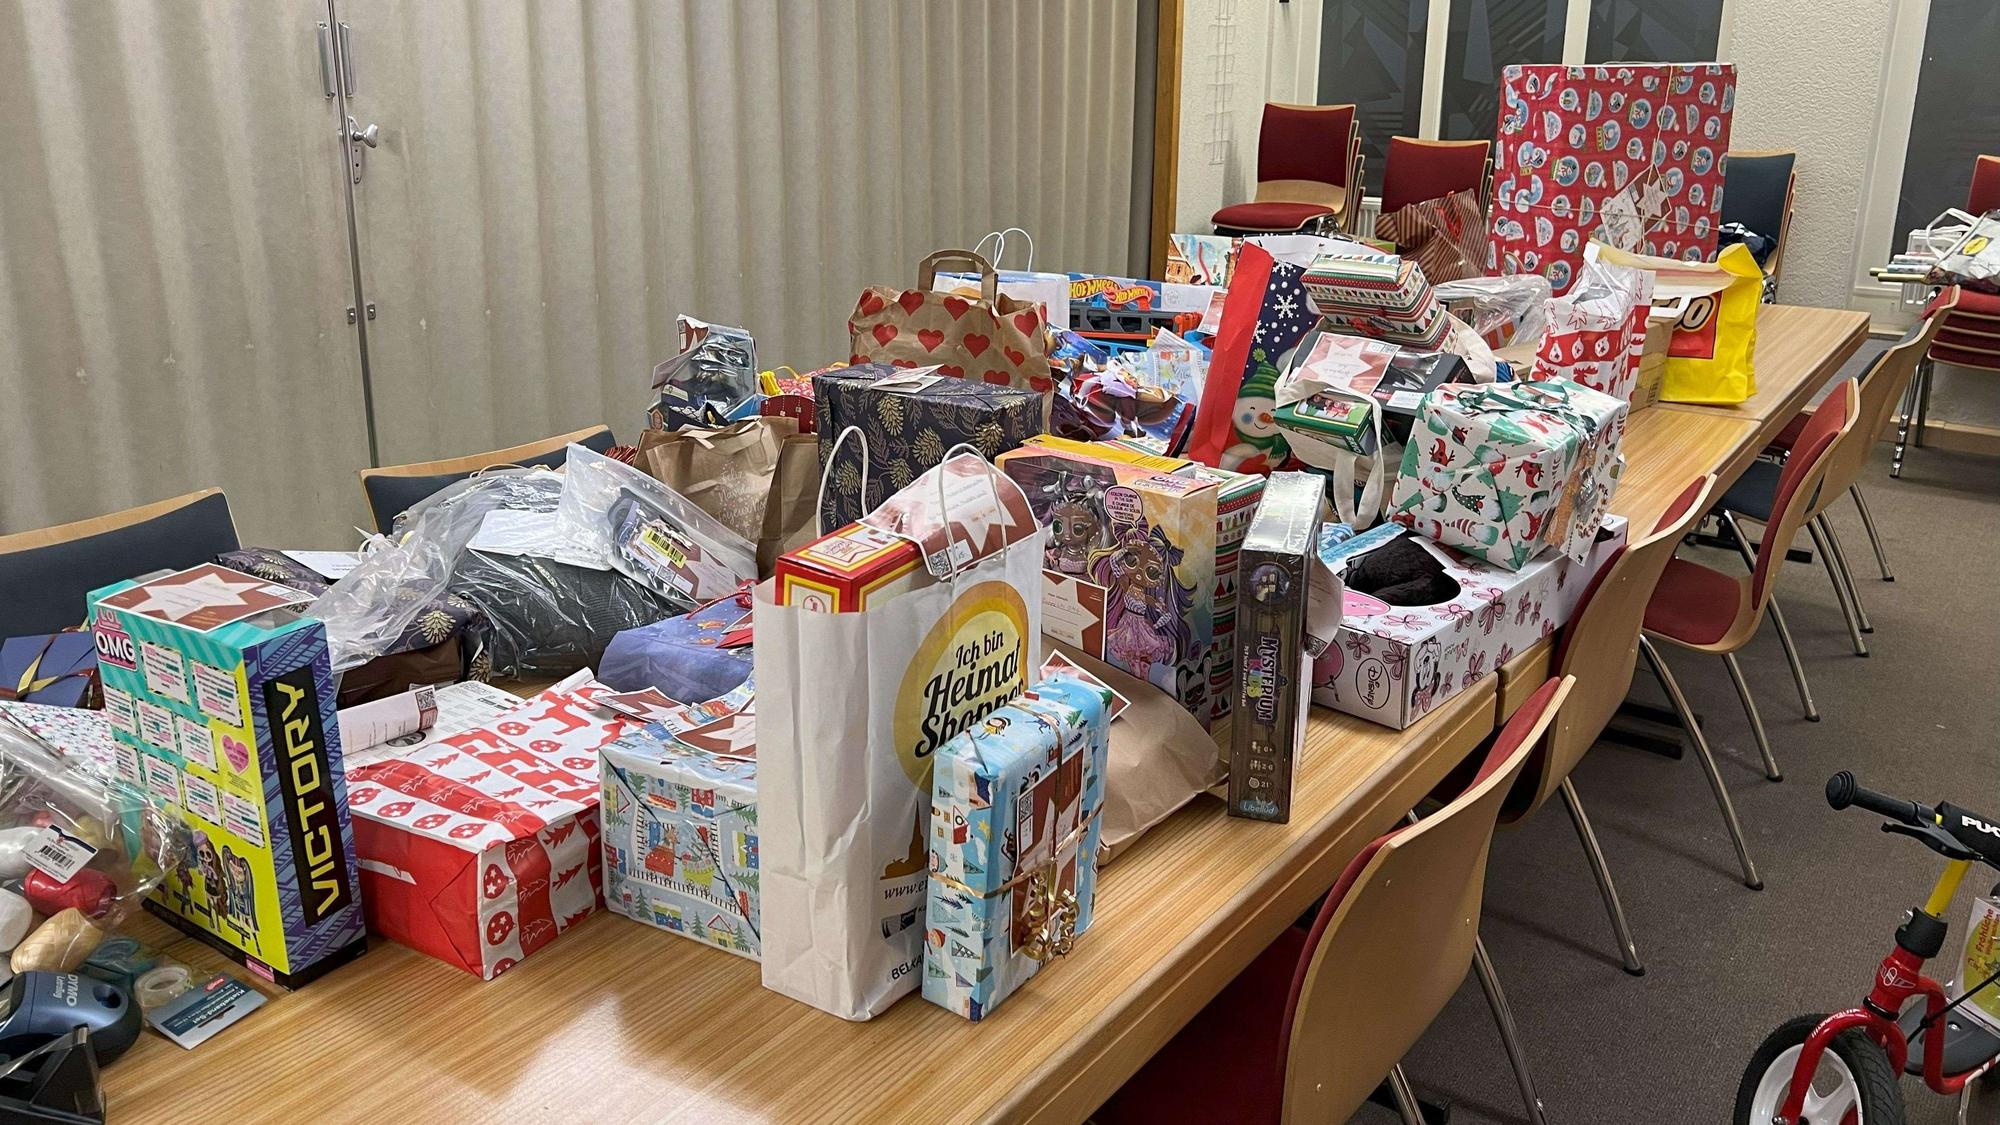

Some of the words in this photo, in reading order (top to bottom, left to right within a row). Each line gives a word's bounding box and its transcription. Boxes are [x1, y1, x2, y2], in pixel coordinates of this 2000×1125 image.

[955, 640, 980, 669] Ich
[983, 630, 1004, 656] bin
[1247, 658, 1263, 699] KIDS
[1256, 636, 1279, 720] MYSTERIUM
[276, 682, 340, 916] VICTORY
[66, 973, 79, 1008] DYMO
